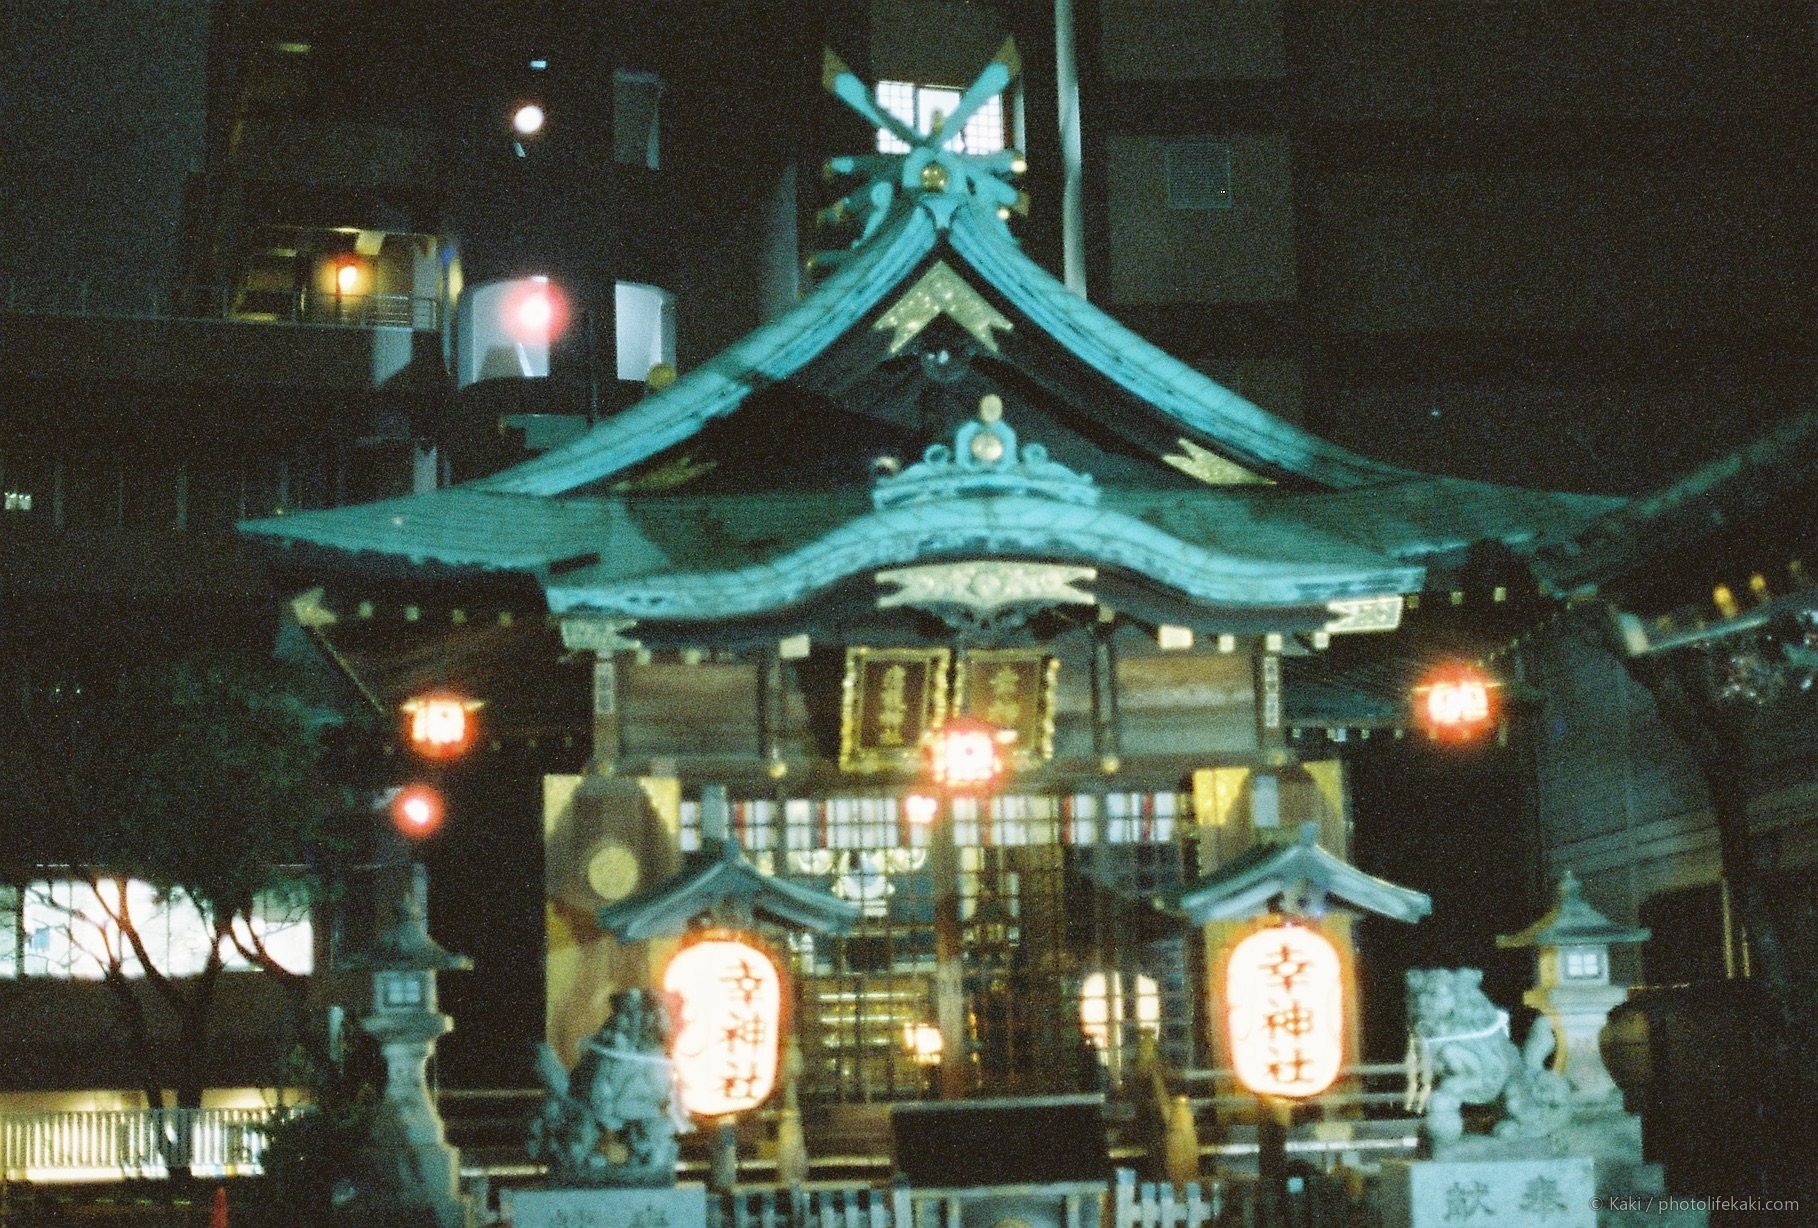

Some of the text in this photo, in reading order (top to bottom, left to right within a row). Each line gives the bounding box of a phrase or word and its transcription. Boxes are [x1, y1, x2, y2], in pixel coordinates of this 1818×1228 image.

[720, 958, 766, 1100] 幸神社
[1257, 944, 1315, 1083] 幸神社
